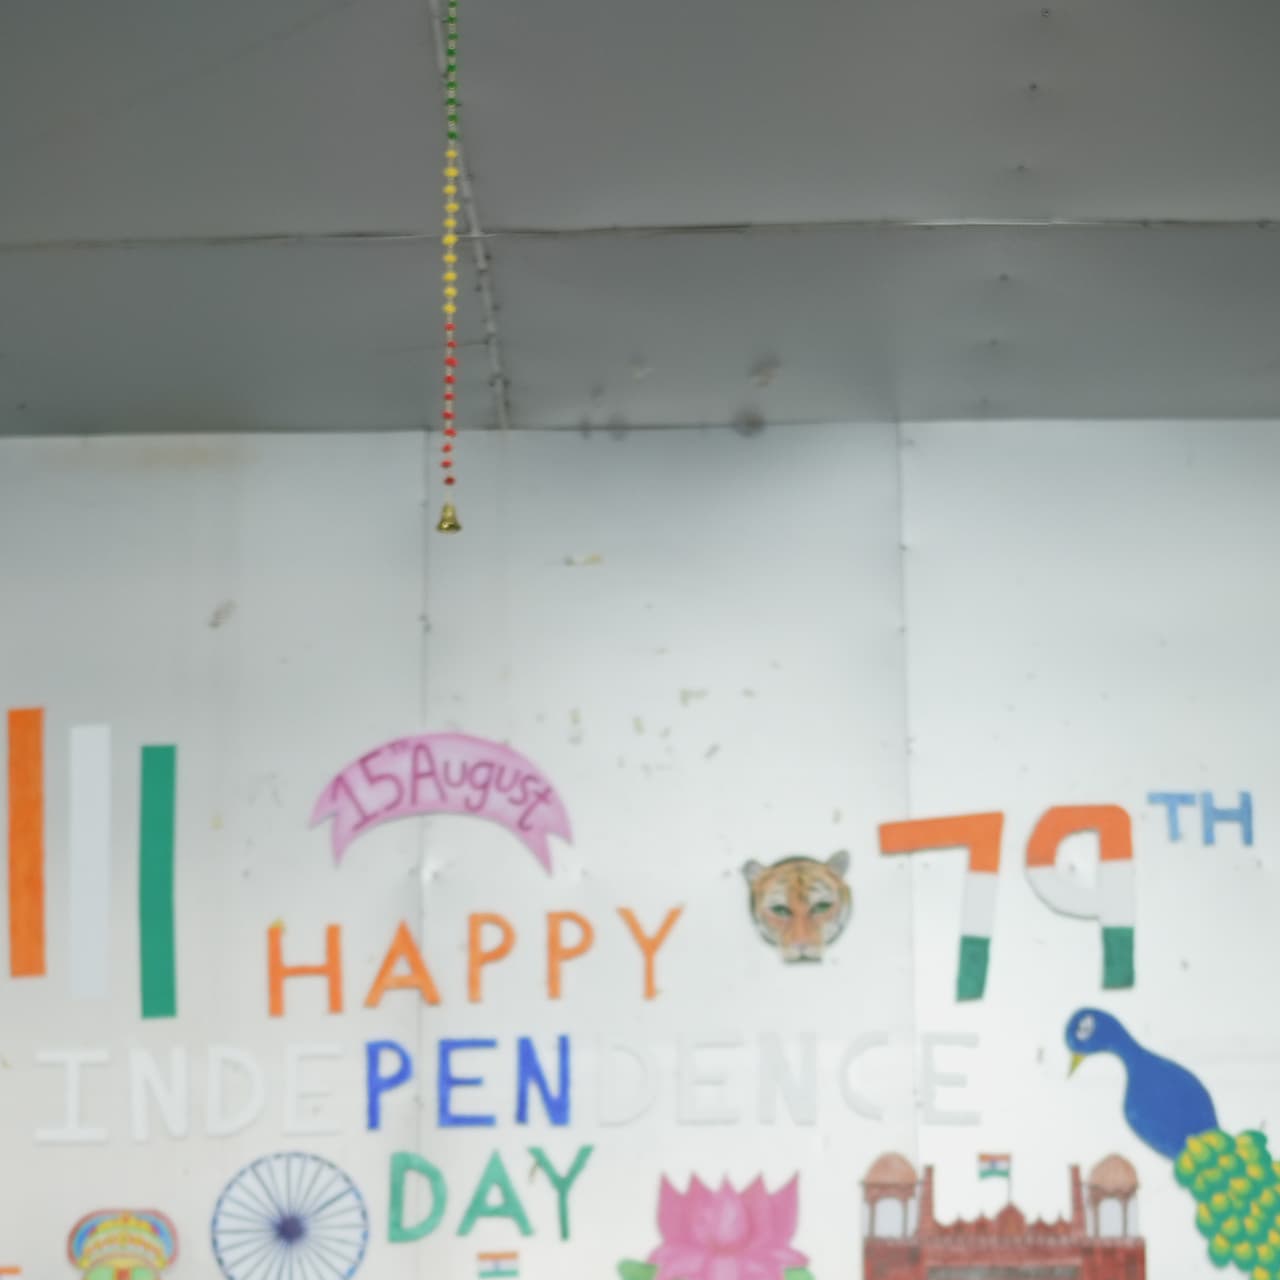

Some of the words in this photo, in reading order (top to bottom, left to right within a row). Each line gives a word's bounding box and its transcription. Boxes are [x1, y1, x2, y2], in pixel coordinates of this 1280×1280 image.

[411, 742, 553, 831] August
[266, 904, 685, 1018] HAPPY
[34, 1033, 982, 1146] INDEPENDENCE
[388, 1145, 595, 1244] DAY
